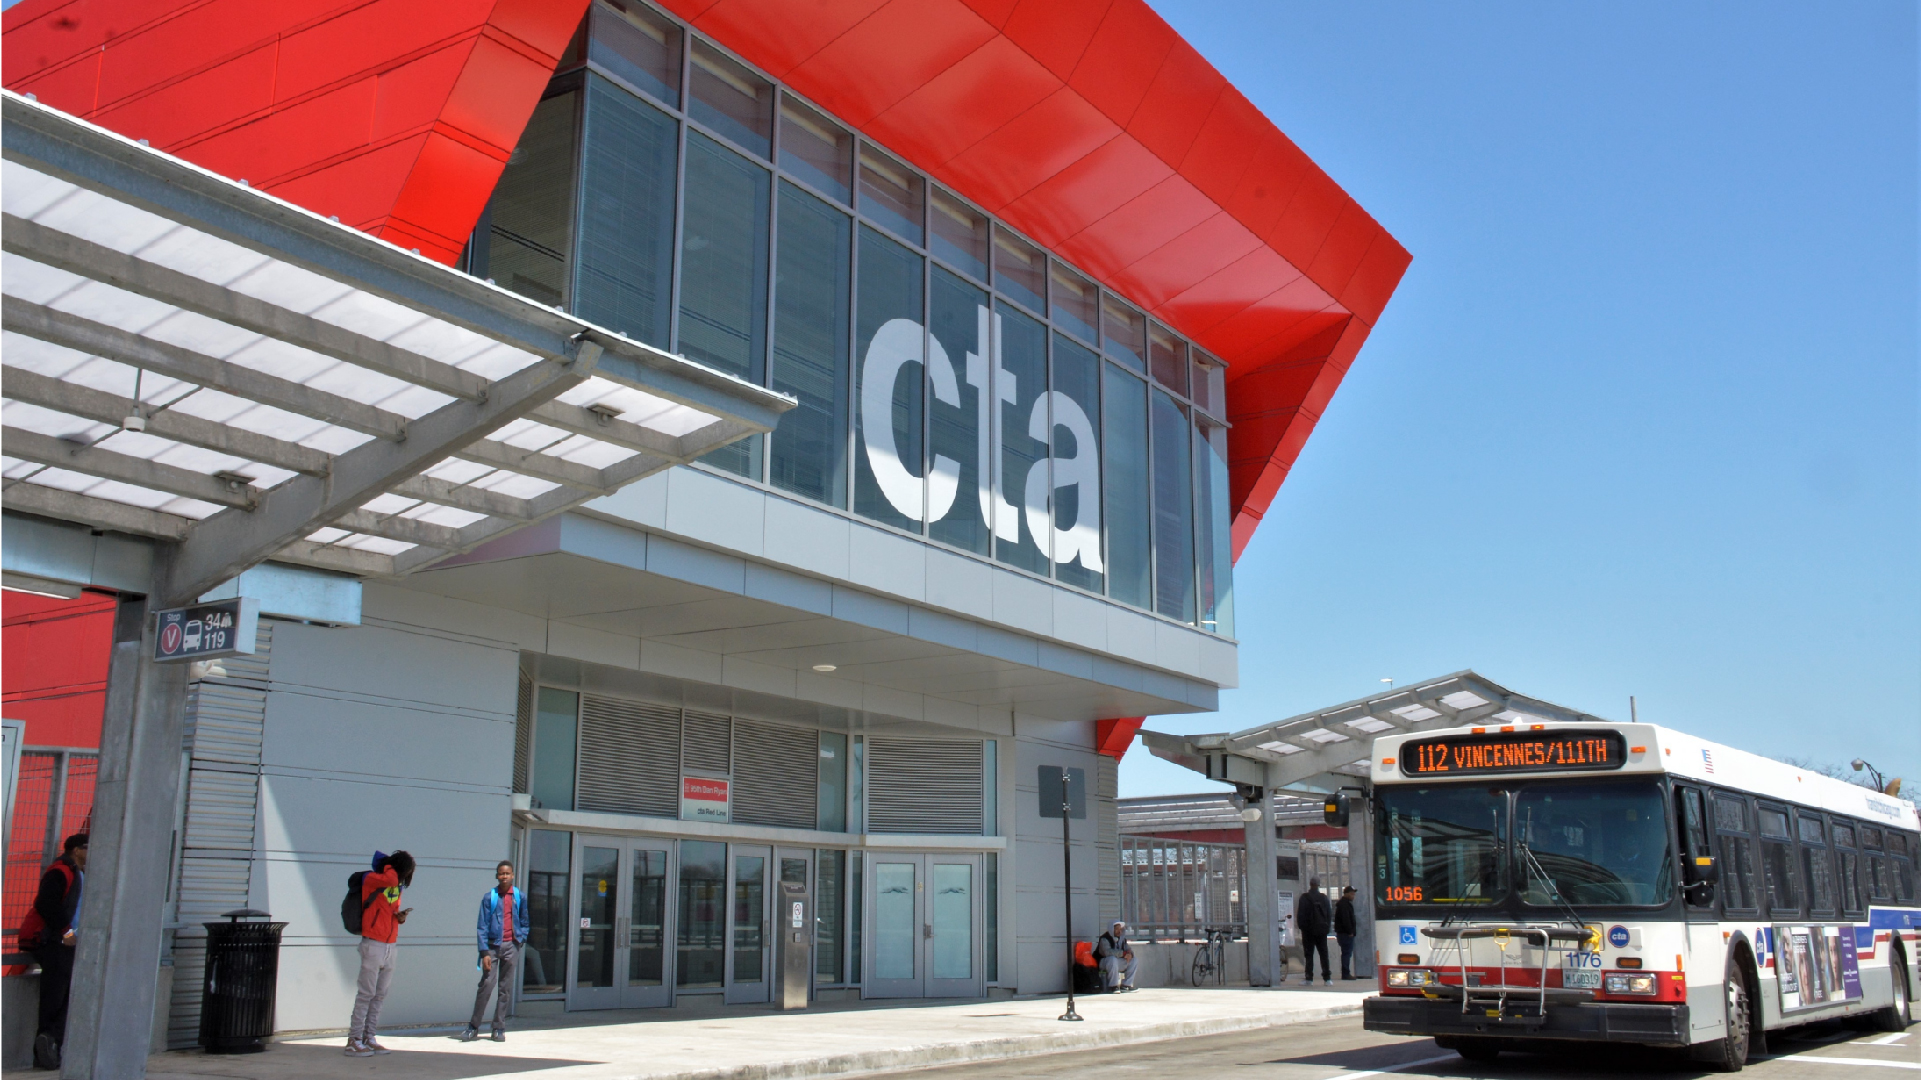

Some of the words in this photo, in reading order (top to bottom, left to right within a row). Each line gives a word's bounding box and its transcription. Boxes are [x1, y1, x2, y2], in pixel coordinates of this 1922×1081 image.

[861, 304, 1103, 574] cta
[167, 613, 181, 622] Stop
[205, 613, 221, 631] 34
[167, 628, 178, 648] V
[204, 631, 225, 649] 119
[1418, 744, 1449, 772] 112
[1454, 739, 1607, 768] VINCENNES/111TH
[1385, 886, 1423, 901] 1056
[1611, 932, 1627, 940] cta
[1566, 952, 1602, 968] 1176
